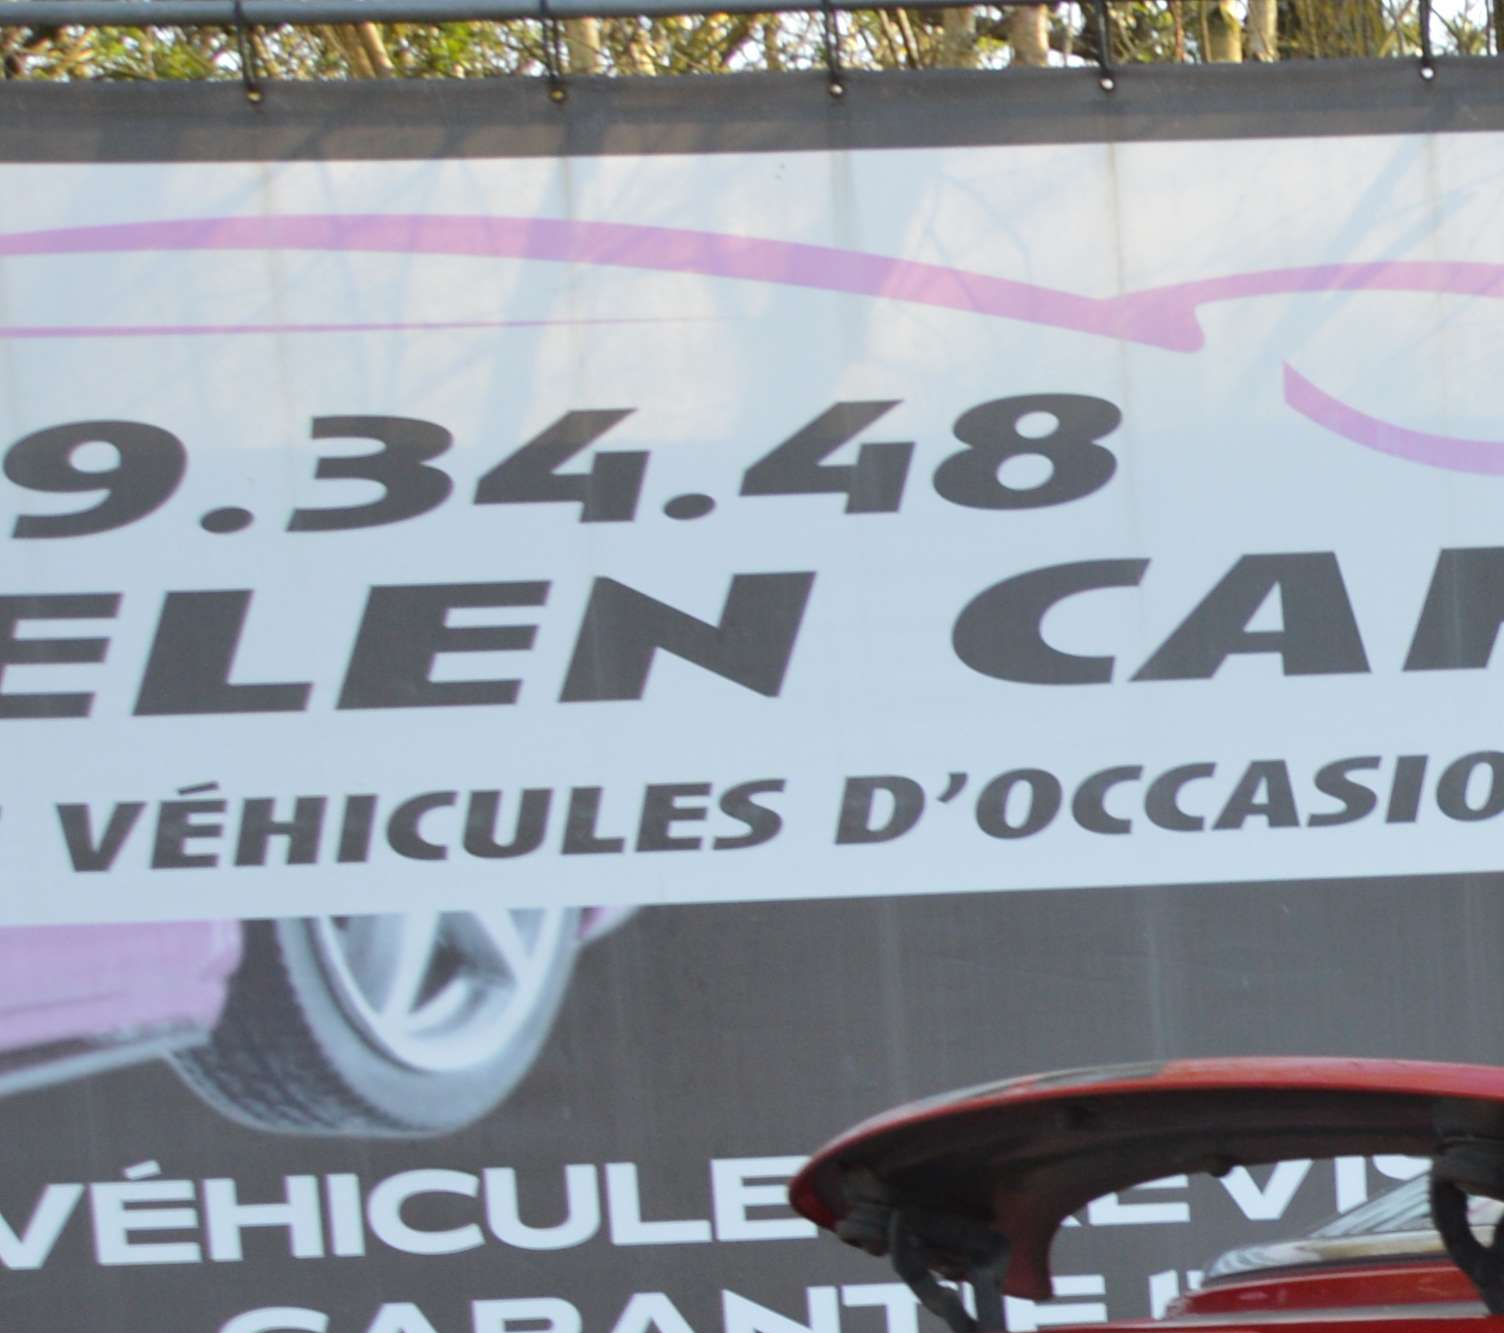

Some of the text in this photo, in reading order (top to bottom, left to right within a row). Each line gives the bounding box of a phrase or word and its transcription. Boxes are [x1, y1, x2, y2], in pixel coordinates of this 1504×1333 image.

[3, 392, 1123, 540] 9.34.48
[56, 778, 787, 873] VÉHICULES
[0, 1155, 820, 1271] VÉHICULE
